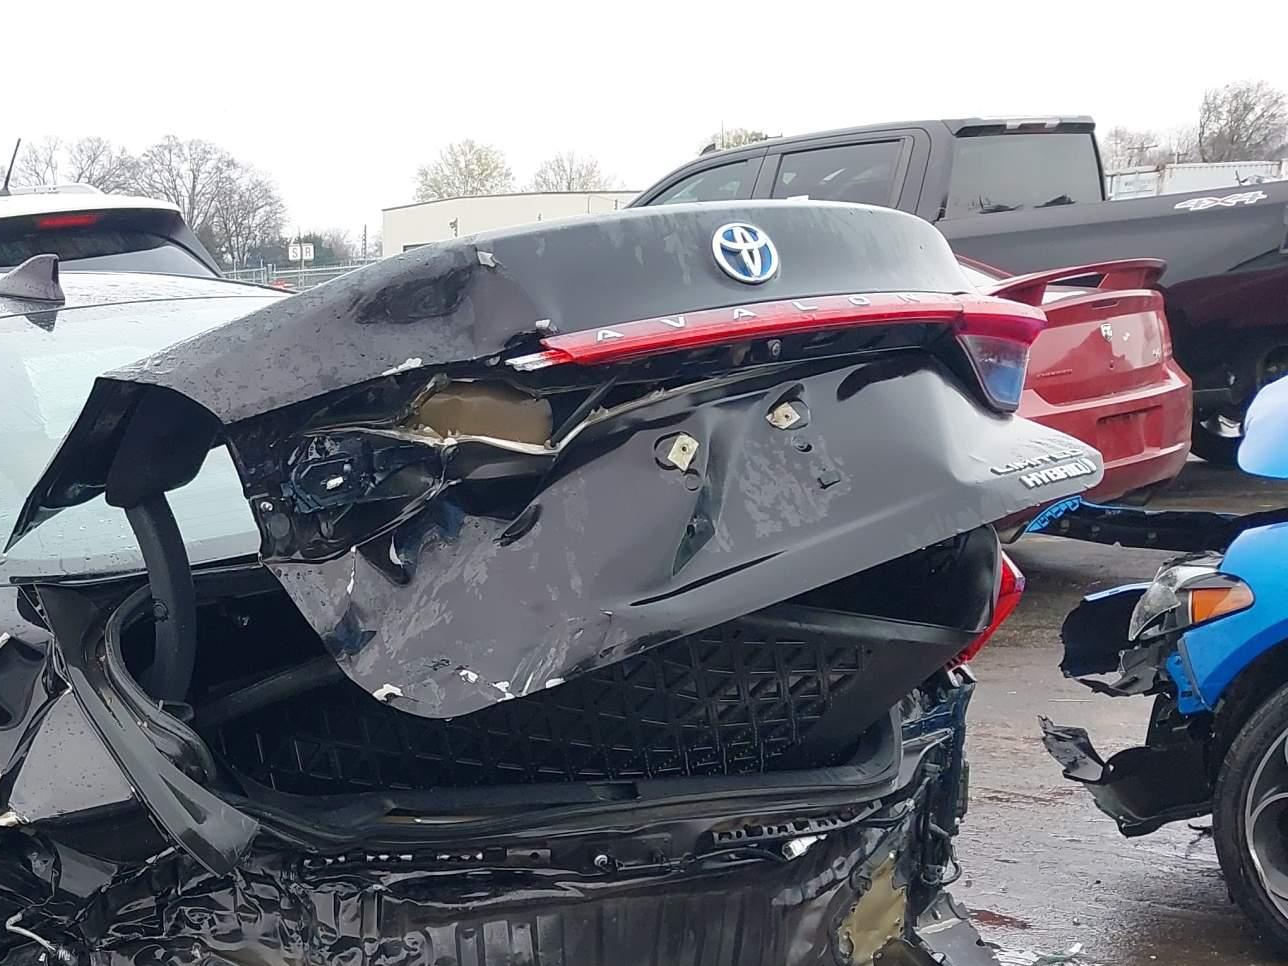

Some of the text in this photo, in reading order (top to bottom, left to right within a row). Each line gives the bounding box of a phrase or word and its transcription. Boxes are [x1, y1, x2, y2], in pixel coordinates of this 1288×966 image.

[595, 293, 922, 343] AVALON
[991, 448, 1085, 475] LIMITED
[1019, 461, 1092, 490] HYBRID
